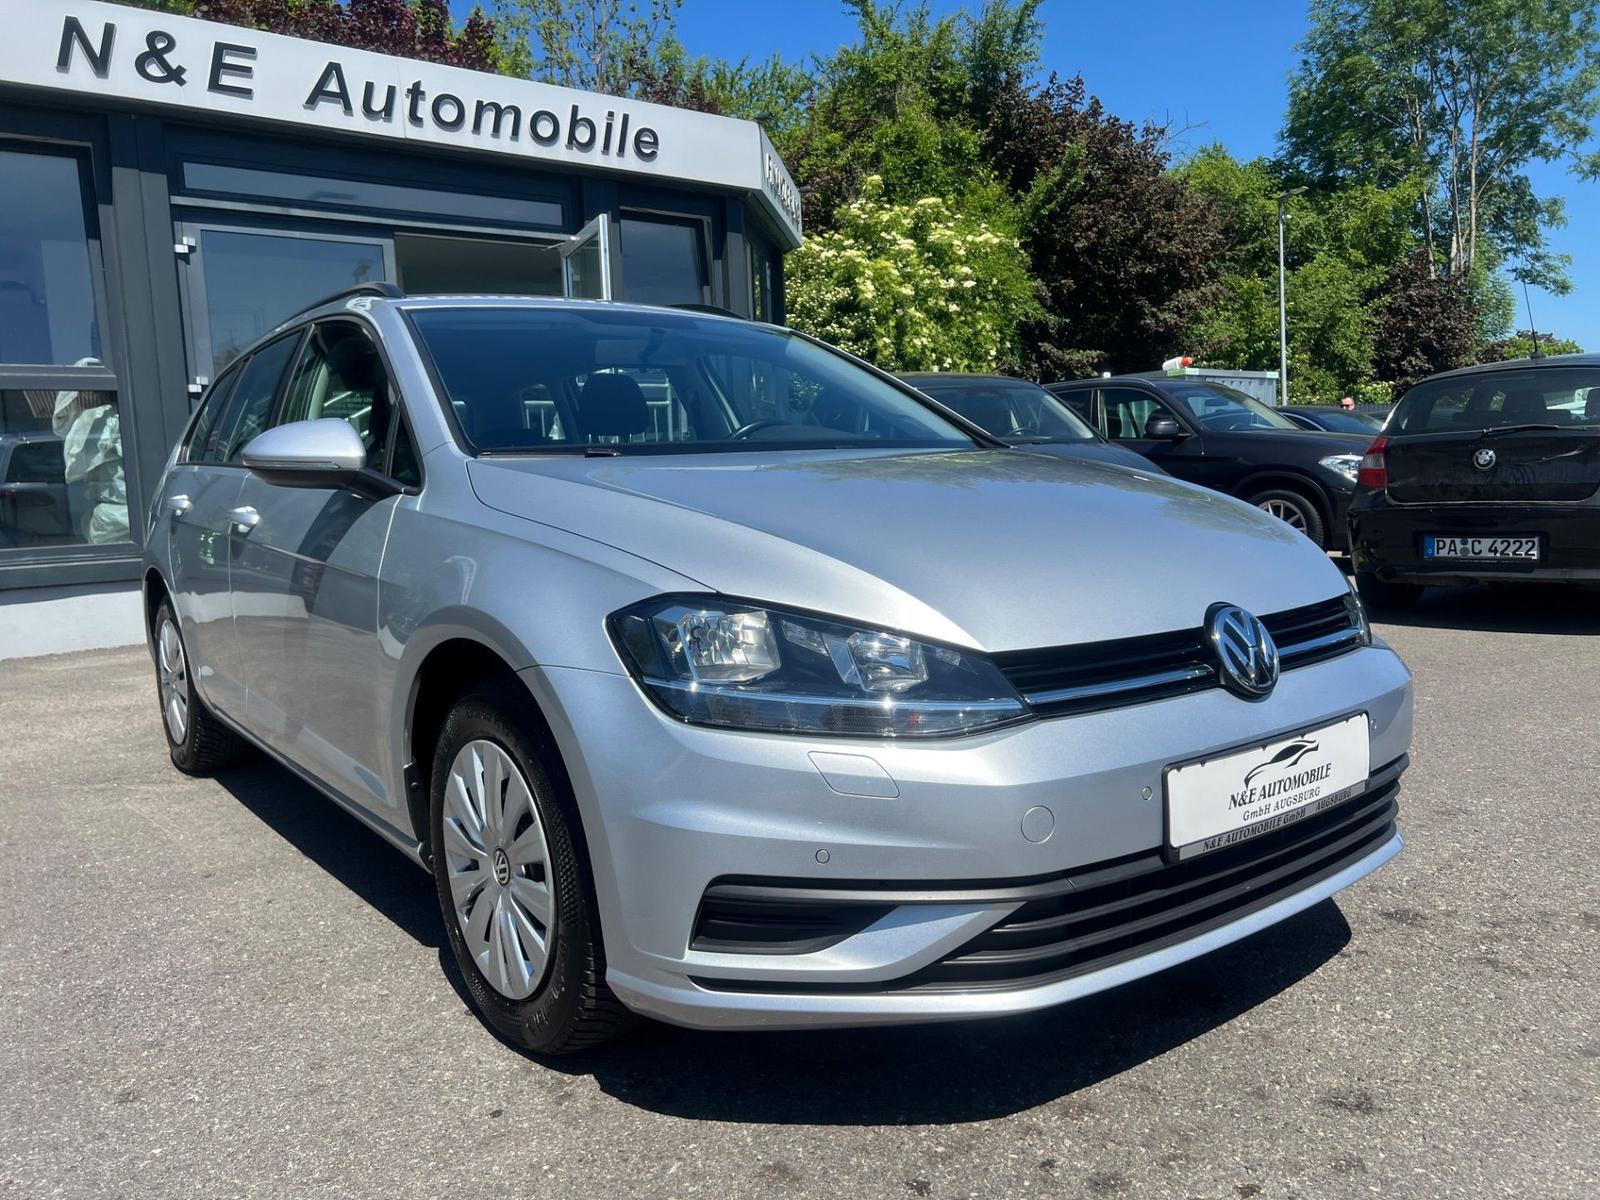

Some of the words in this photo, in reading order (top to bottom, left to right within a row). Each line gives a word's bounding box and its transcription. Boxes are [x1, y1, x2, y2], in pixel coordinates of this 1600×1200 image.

[303, 61, 660, 162] Automobile
[1488, 539, 1536, 556] 4222
[1228, 787, 1257, 811] N&E
[1258, 762, 1332, 802] AUTOMOBILE
[1242, 803, 1271, 822] GmbH
[1273, 786, 1321, 812] AUGSBURG
[1202, 835, 1224, 852] N&E
[1224, 816, 1283, 847] AUTOMOBILE
[1283, 807, 1307, 825] GmbH
[1315, 788, 1352, 812] AUGSBURG
